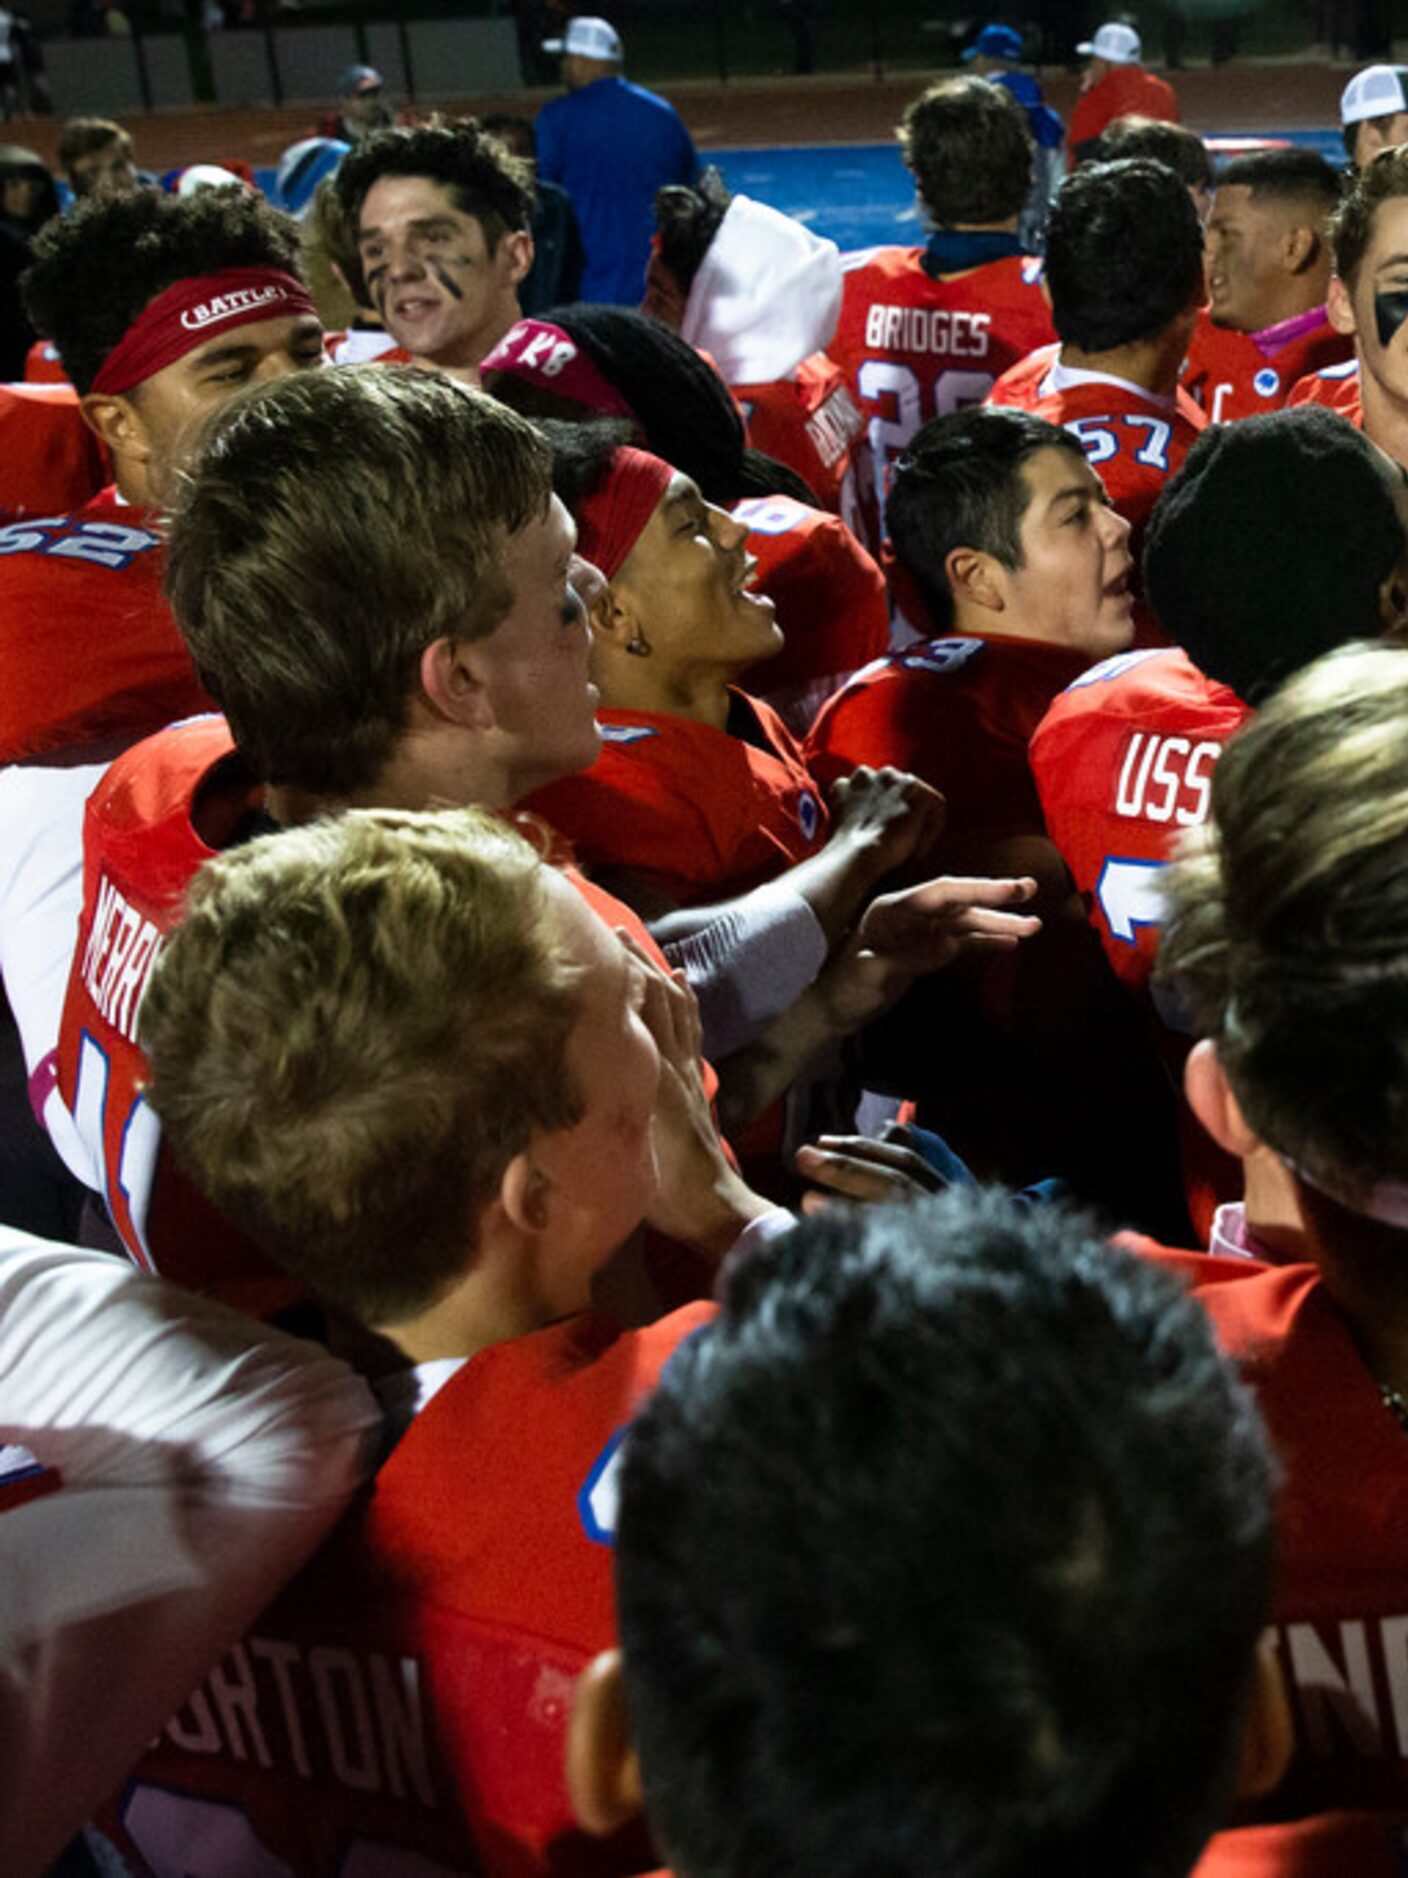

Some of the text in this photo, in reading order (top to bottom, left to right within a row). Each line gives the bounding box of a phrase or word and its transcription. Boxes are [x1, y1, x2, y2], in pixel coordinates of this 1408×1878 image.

[191, 285, 277, 322] BATTLE
[864, 303, 992, 358] BRIDGES
[1063, 413, 1173, 472] 57
